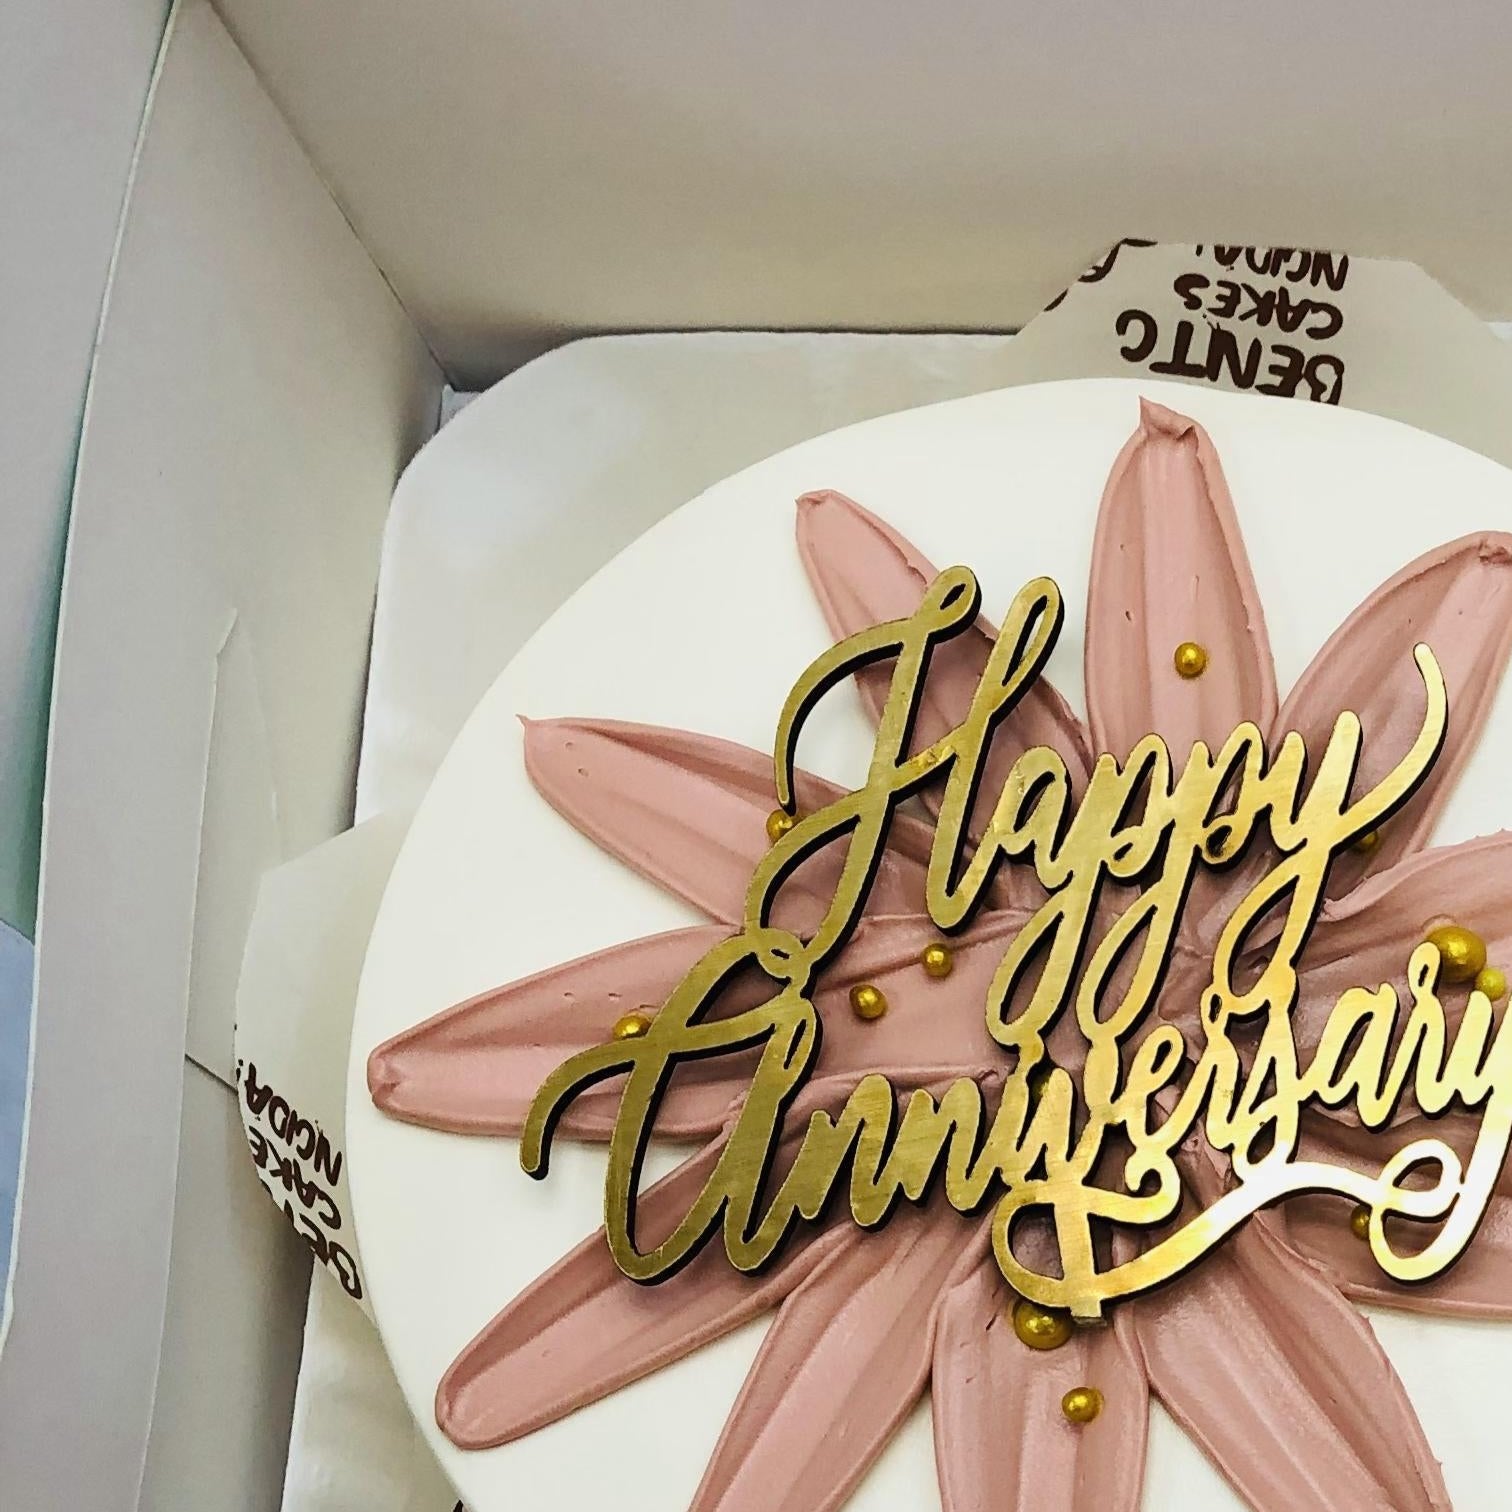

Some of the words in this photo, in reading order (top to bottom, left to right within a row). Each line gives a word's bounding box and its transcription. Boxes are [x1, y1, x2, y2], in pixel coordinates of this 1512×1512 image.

[1173, 272, 1344, 341] CAKES
[740, 564, 1450, 1048] Happy
[248, 1125, 342, 1231] CAKE
